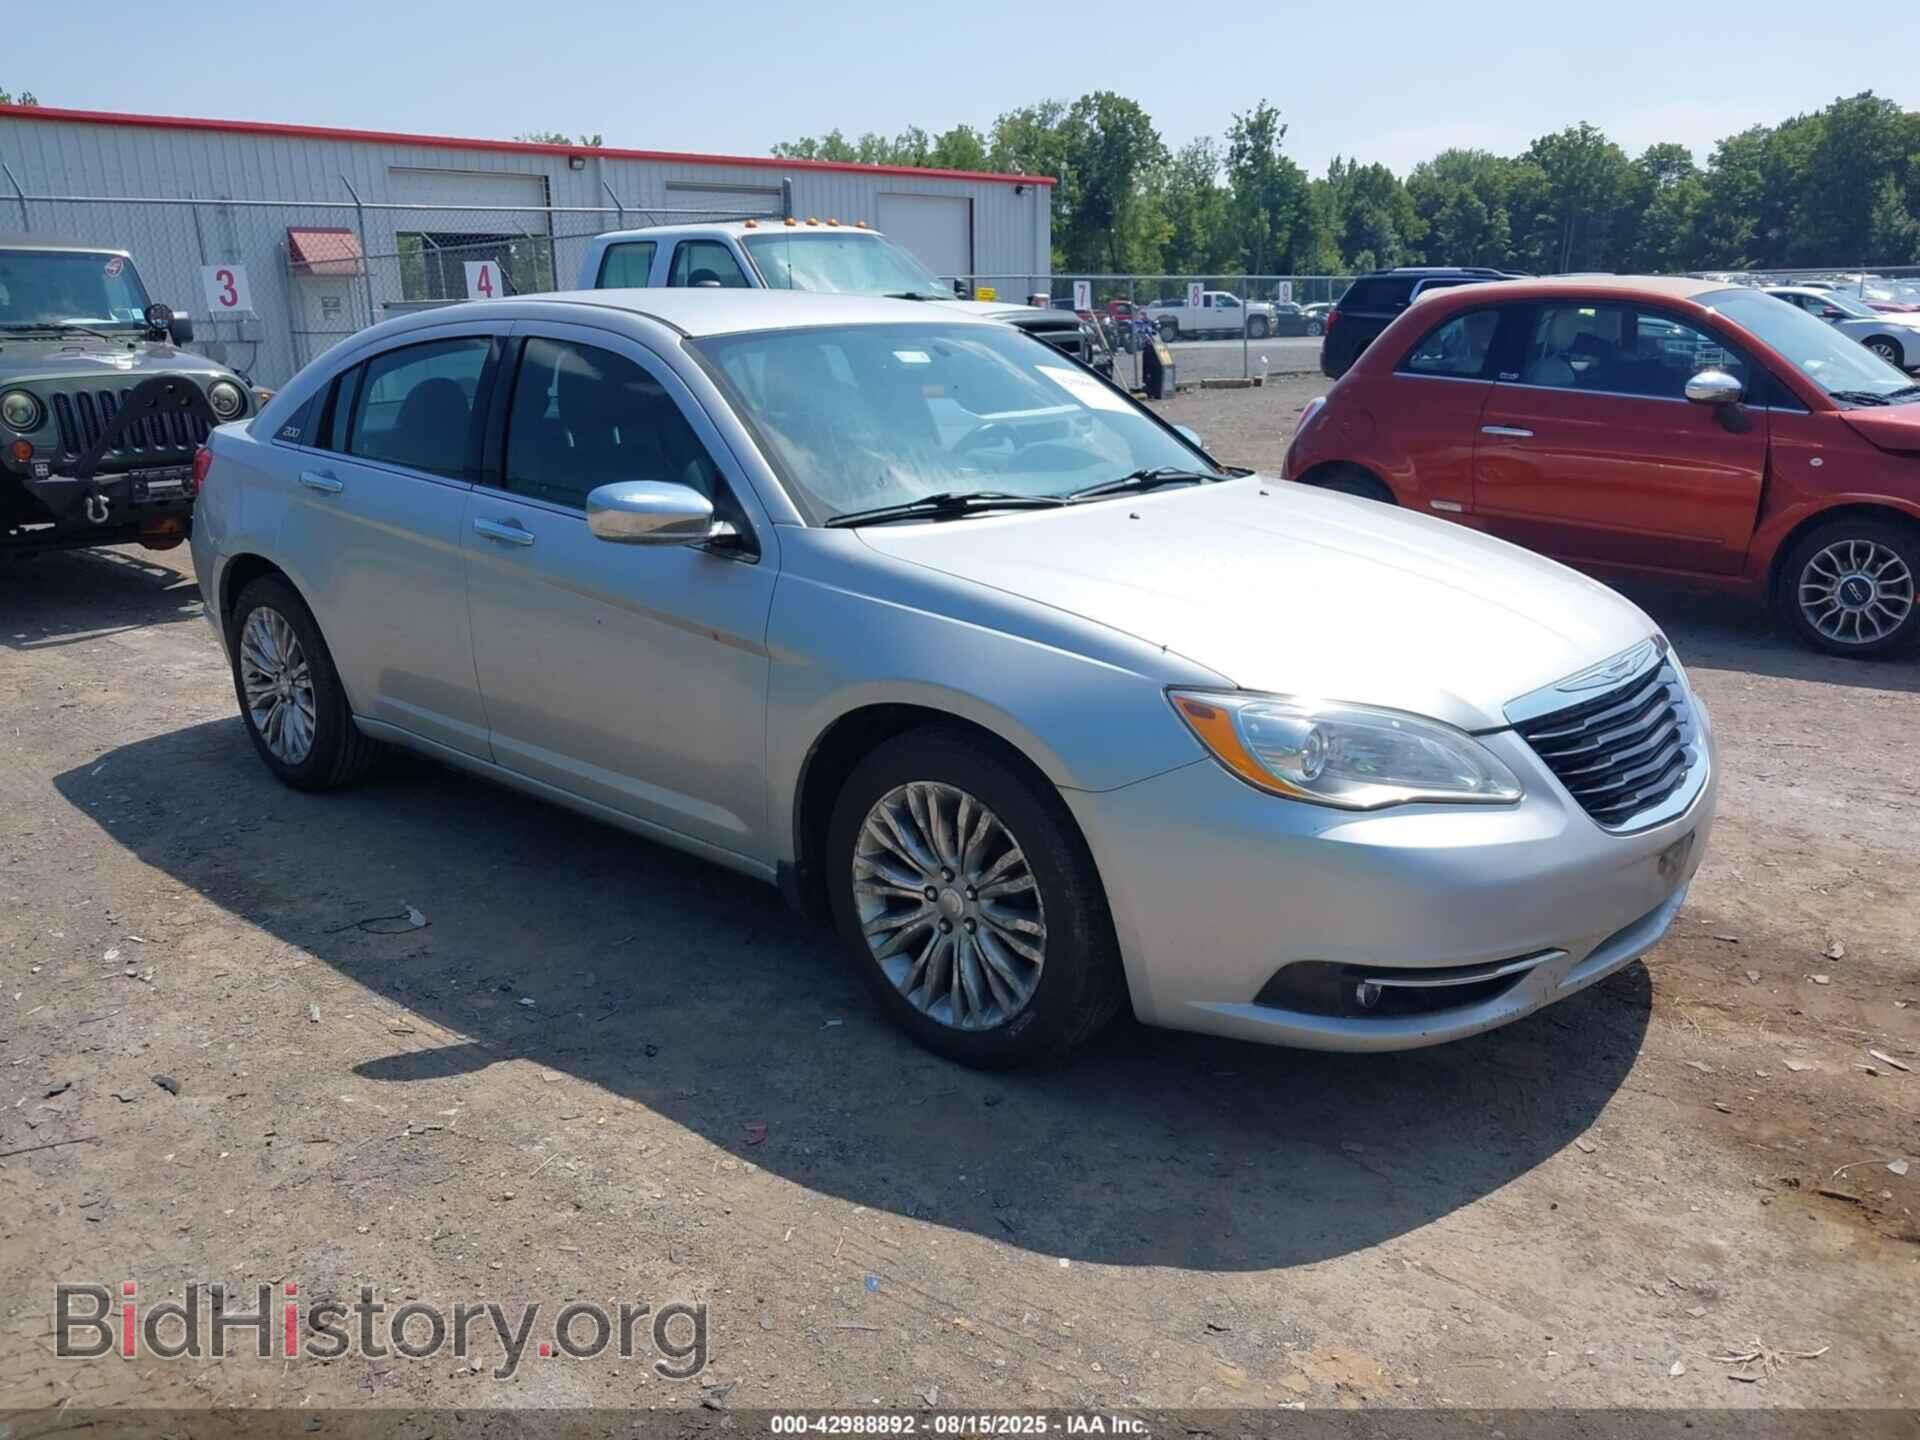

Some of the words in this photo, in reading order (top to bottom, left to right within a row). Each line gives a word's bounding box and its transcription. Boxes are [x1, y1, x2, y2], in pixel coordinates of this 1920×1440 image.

[215, 269, 238, 307] 3
[477, 264, 493, 298] 4
[1078, 284, 1087, 307] 7
[1191, 285, 1200, 306] 8
